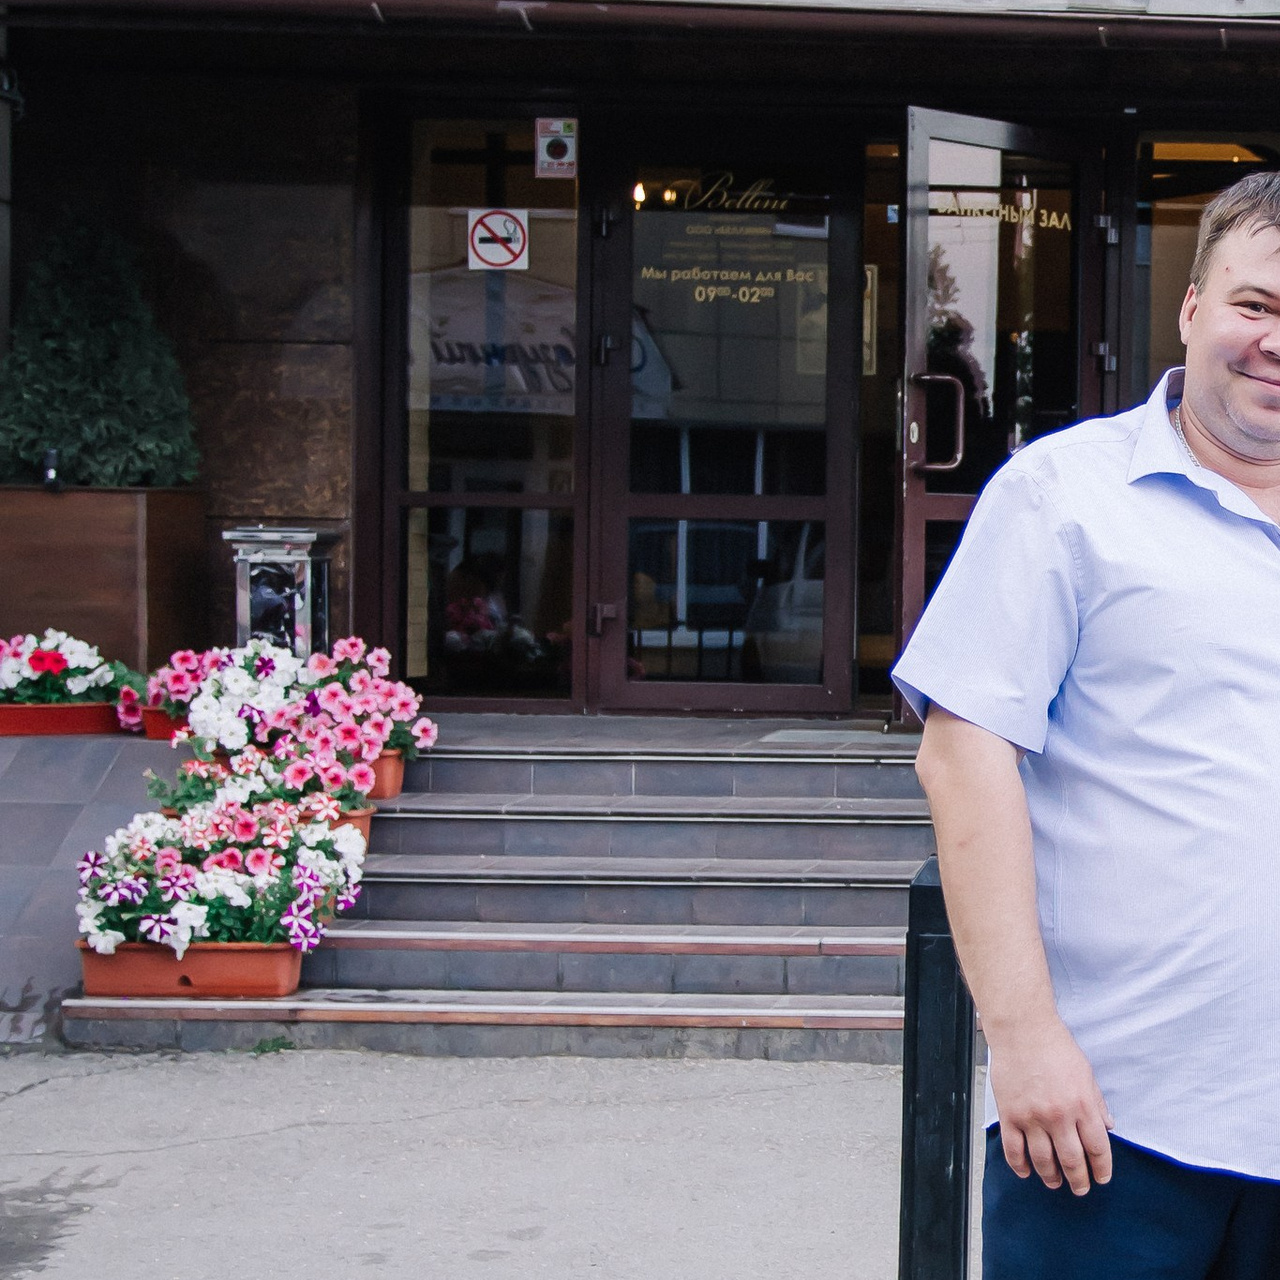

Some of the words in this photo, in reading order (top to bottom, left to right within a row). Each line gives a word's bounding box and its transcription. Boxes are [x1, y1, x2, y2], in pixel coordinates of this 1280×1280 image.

[667, 172, 789, 210] Bellini
[1039, 209, 1072, 232] ЗАЛ
[641, 266, 667, 280] Мы
[671, 266, 751, 284] работаем
[755, 270, 782, 283] для
[786, 269, 816, 283] Вас
